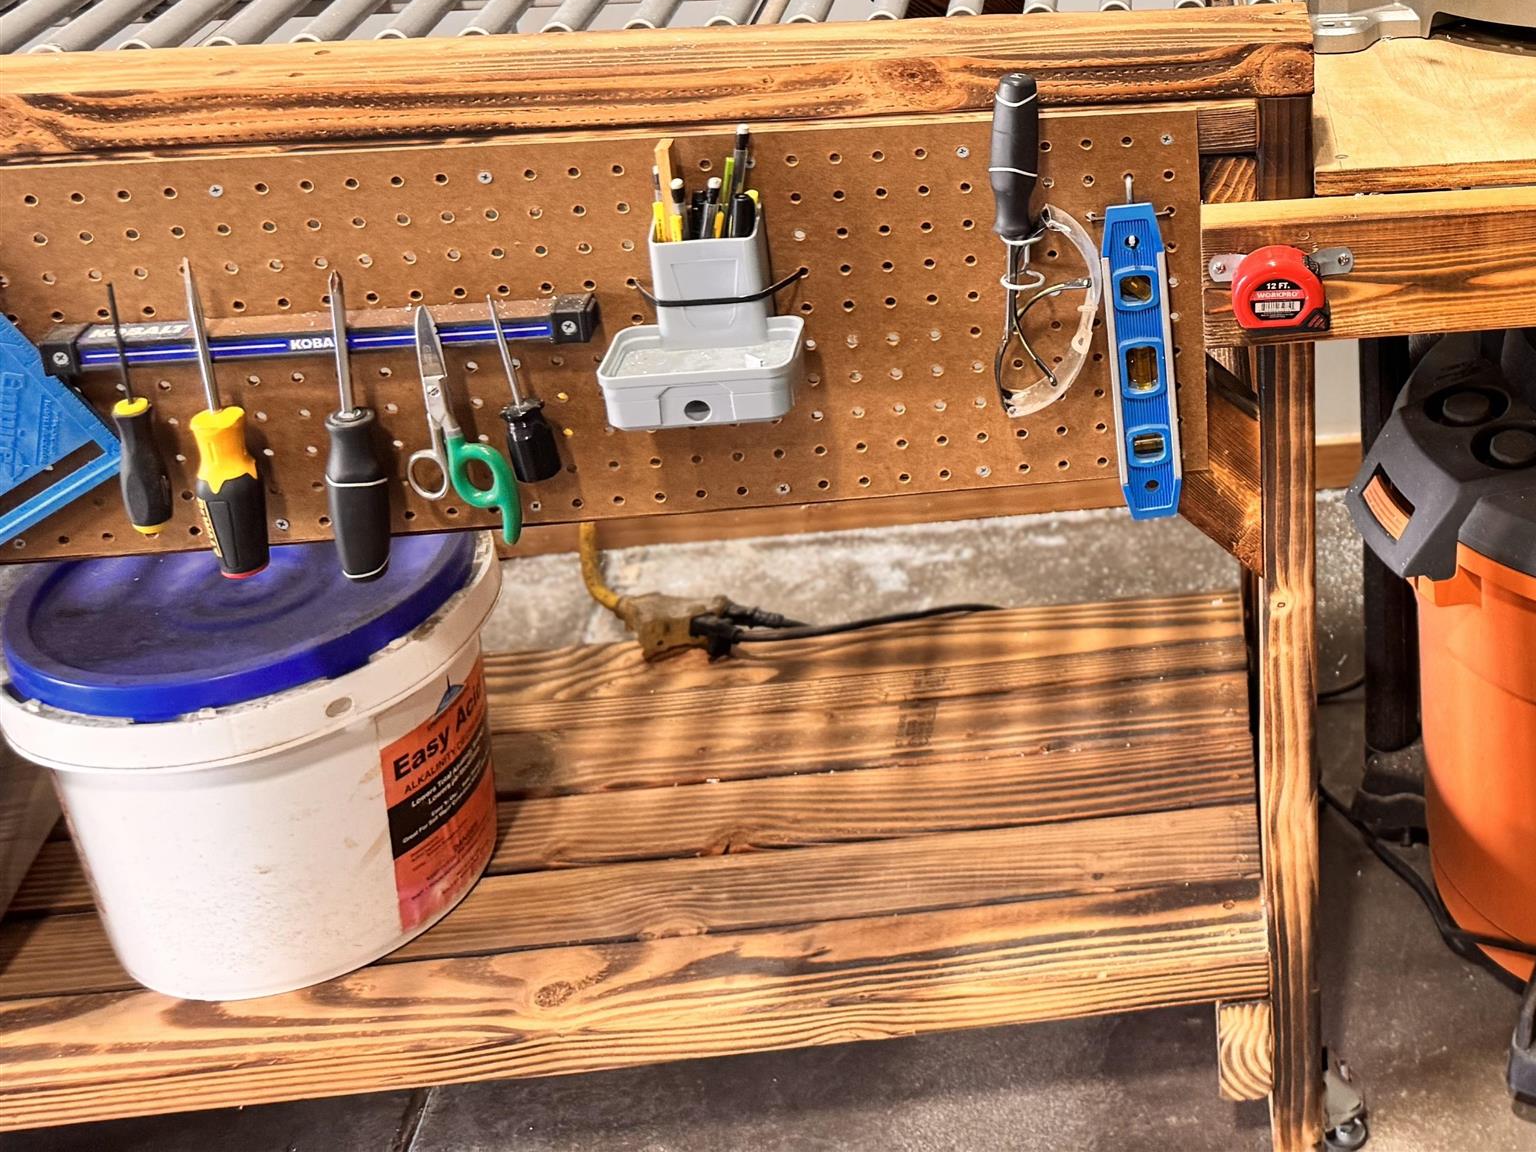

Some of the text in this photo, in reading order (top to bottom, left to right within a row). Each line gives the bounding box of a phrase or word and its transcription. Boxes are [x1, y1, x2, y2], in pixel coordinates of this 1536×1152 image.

[1266, 281, 1277, 290] 12
[1256, 291, 1298, 299] WORKPRO
[289, 336, 347, 351] KOBA
[392, 725, 449, 783] Easy
[411, 785, 437, 808] Lowers
